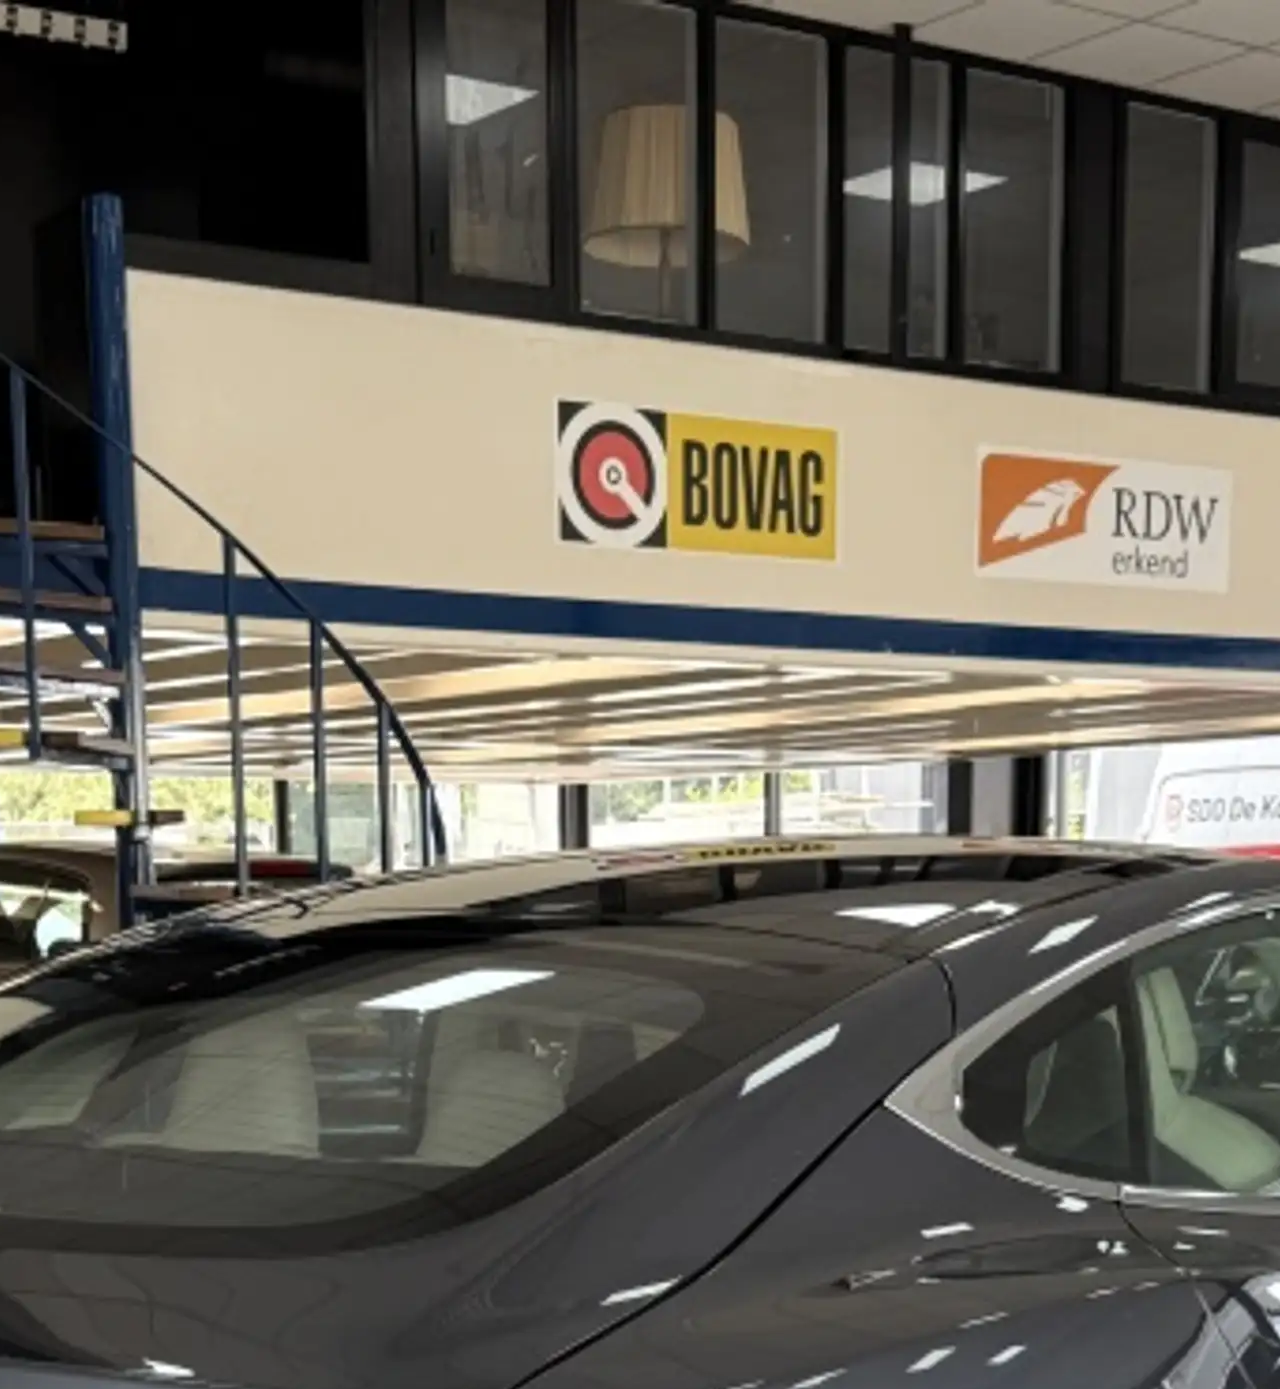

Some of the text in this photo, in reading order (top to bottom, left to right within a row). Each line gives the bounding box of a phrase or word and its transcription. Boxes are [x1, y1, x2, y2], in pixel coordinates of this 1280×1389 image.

[681, 437, 824, 538] BOVAG
[1111, 486, 1219, 545] RDW
[1111, 546, 1189, 579] erkend
